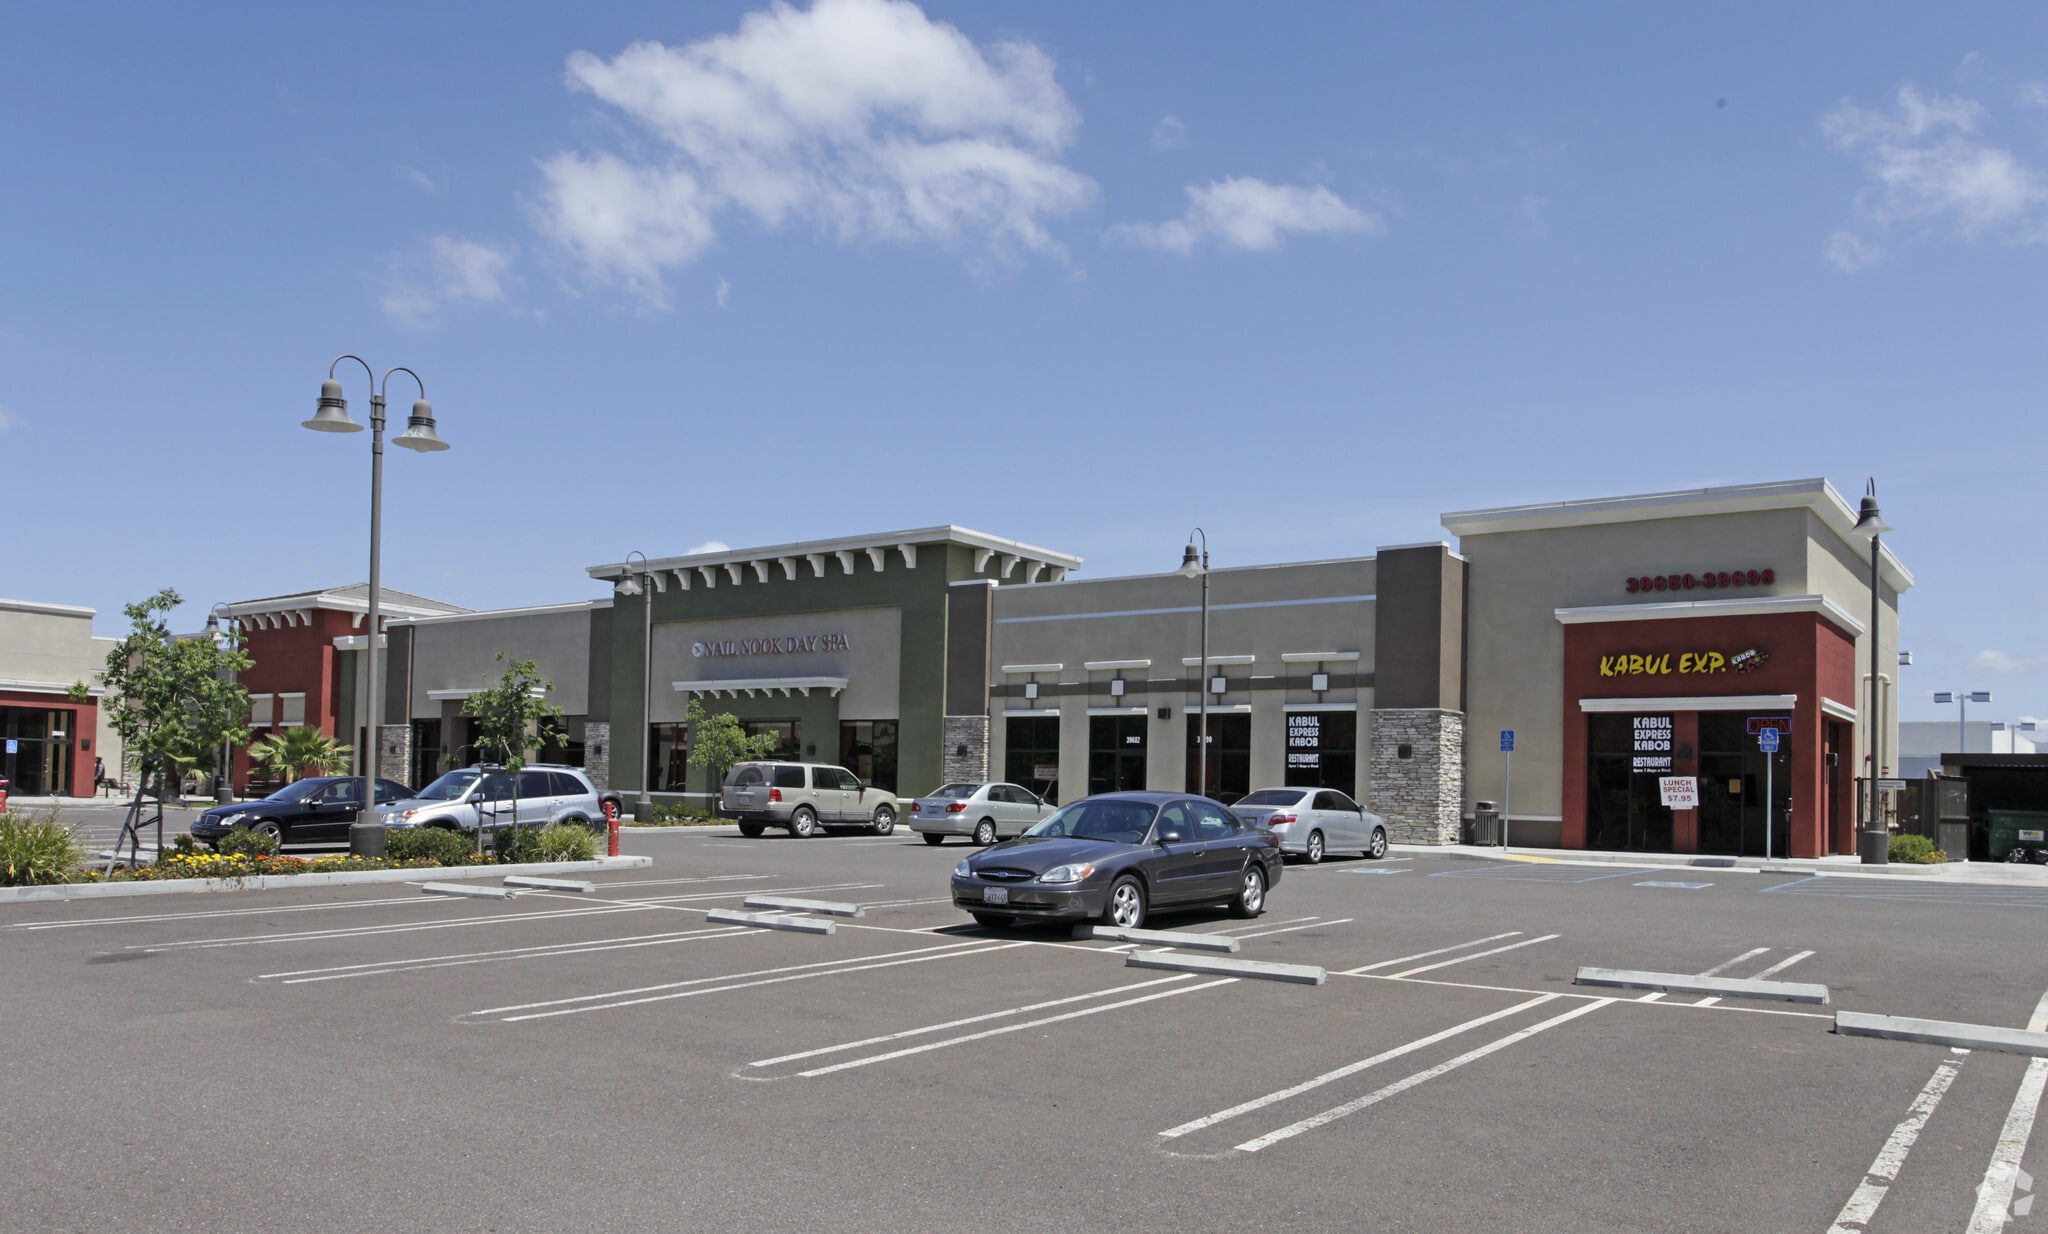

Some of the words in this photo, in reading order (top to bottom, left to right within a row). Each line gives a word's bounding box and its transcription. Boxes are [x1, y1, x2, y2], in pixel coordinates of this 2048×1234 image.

[1625, 568, 1776, 594] 39650-39698
[704, 641, 737, 657] NAIL
[741, 637, 784, 655] NOOK
[786, 636, 818, 653] DAY
[821, 633, 850, 651] SPA
[1600, 654, 1672, 677] KABUL
[1679, 652, 1727, 674] EXP.
[1288, 716, 1320, 727] KABUL
[1633, 717, 1672, 729] KABUL
[1749, 719, 1790, 732] OPEN
[1289, 727, 1319, 737] EXPRESS
[1634, 729, 1671, 740] EXPRESS
[1289, 737, 1319, 747] KABOB
[1634, 740, 1671, 751] KABOB
[1288, 753, 1319, 763] RESTAURANT
[1632, 756, 1671, 767] RESTAURANT
